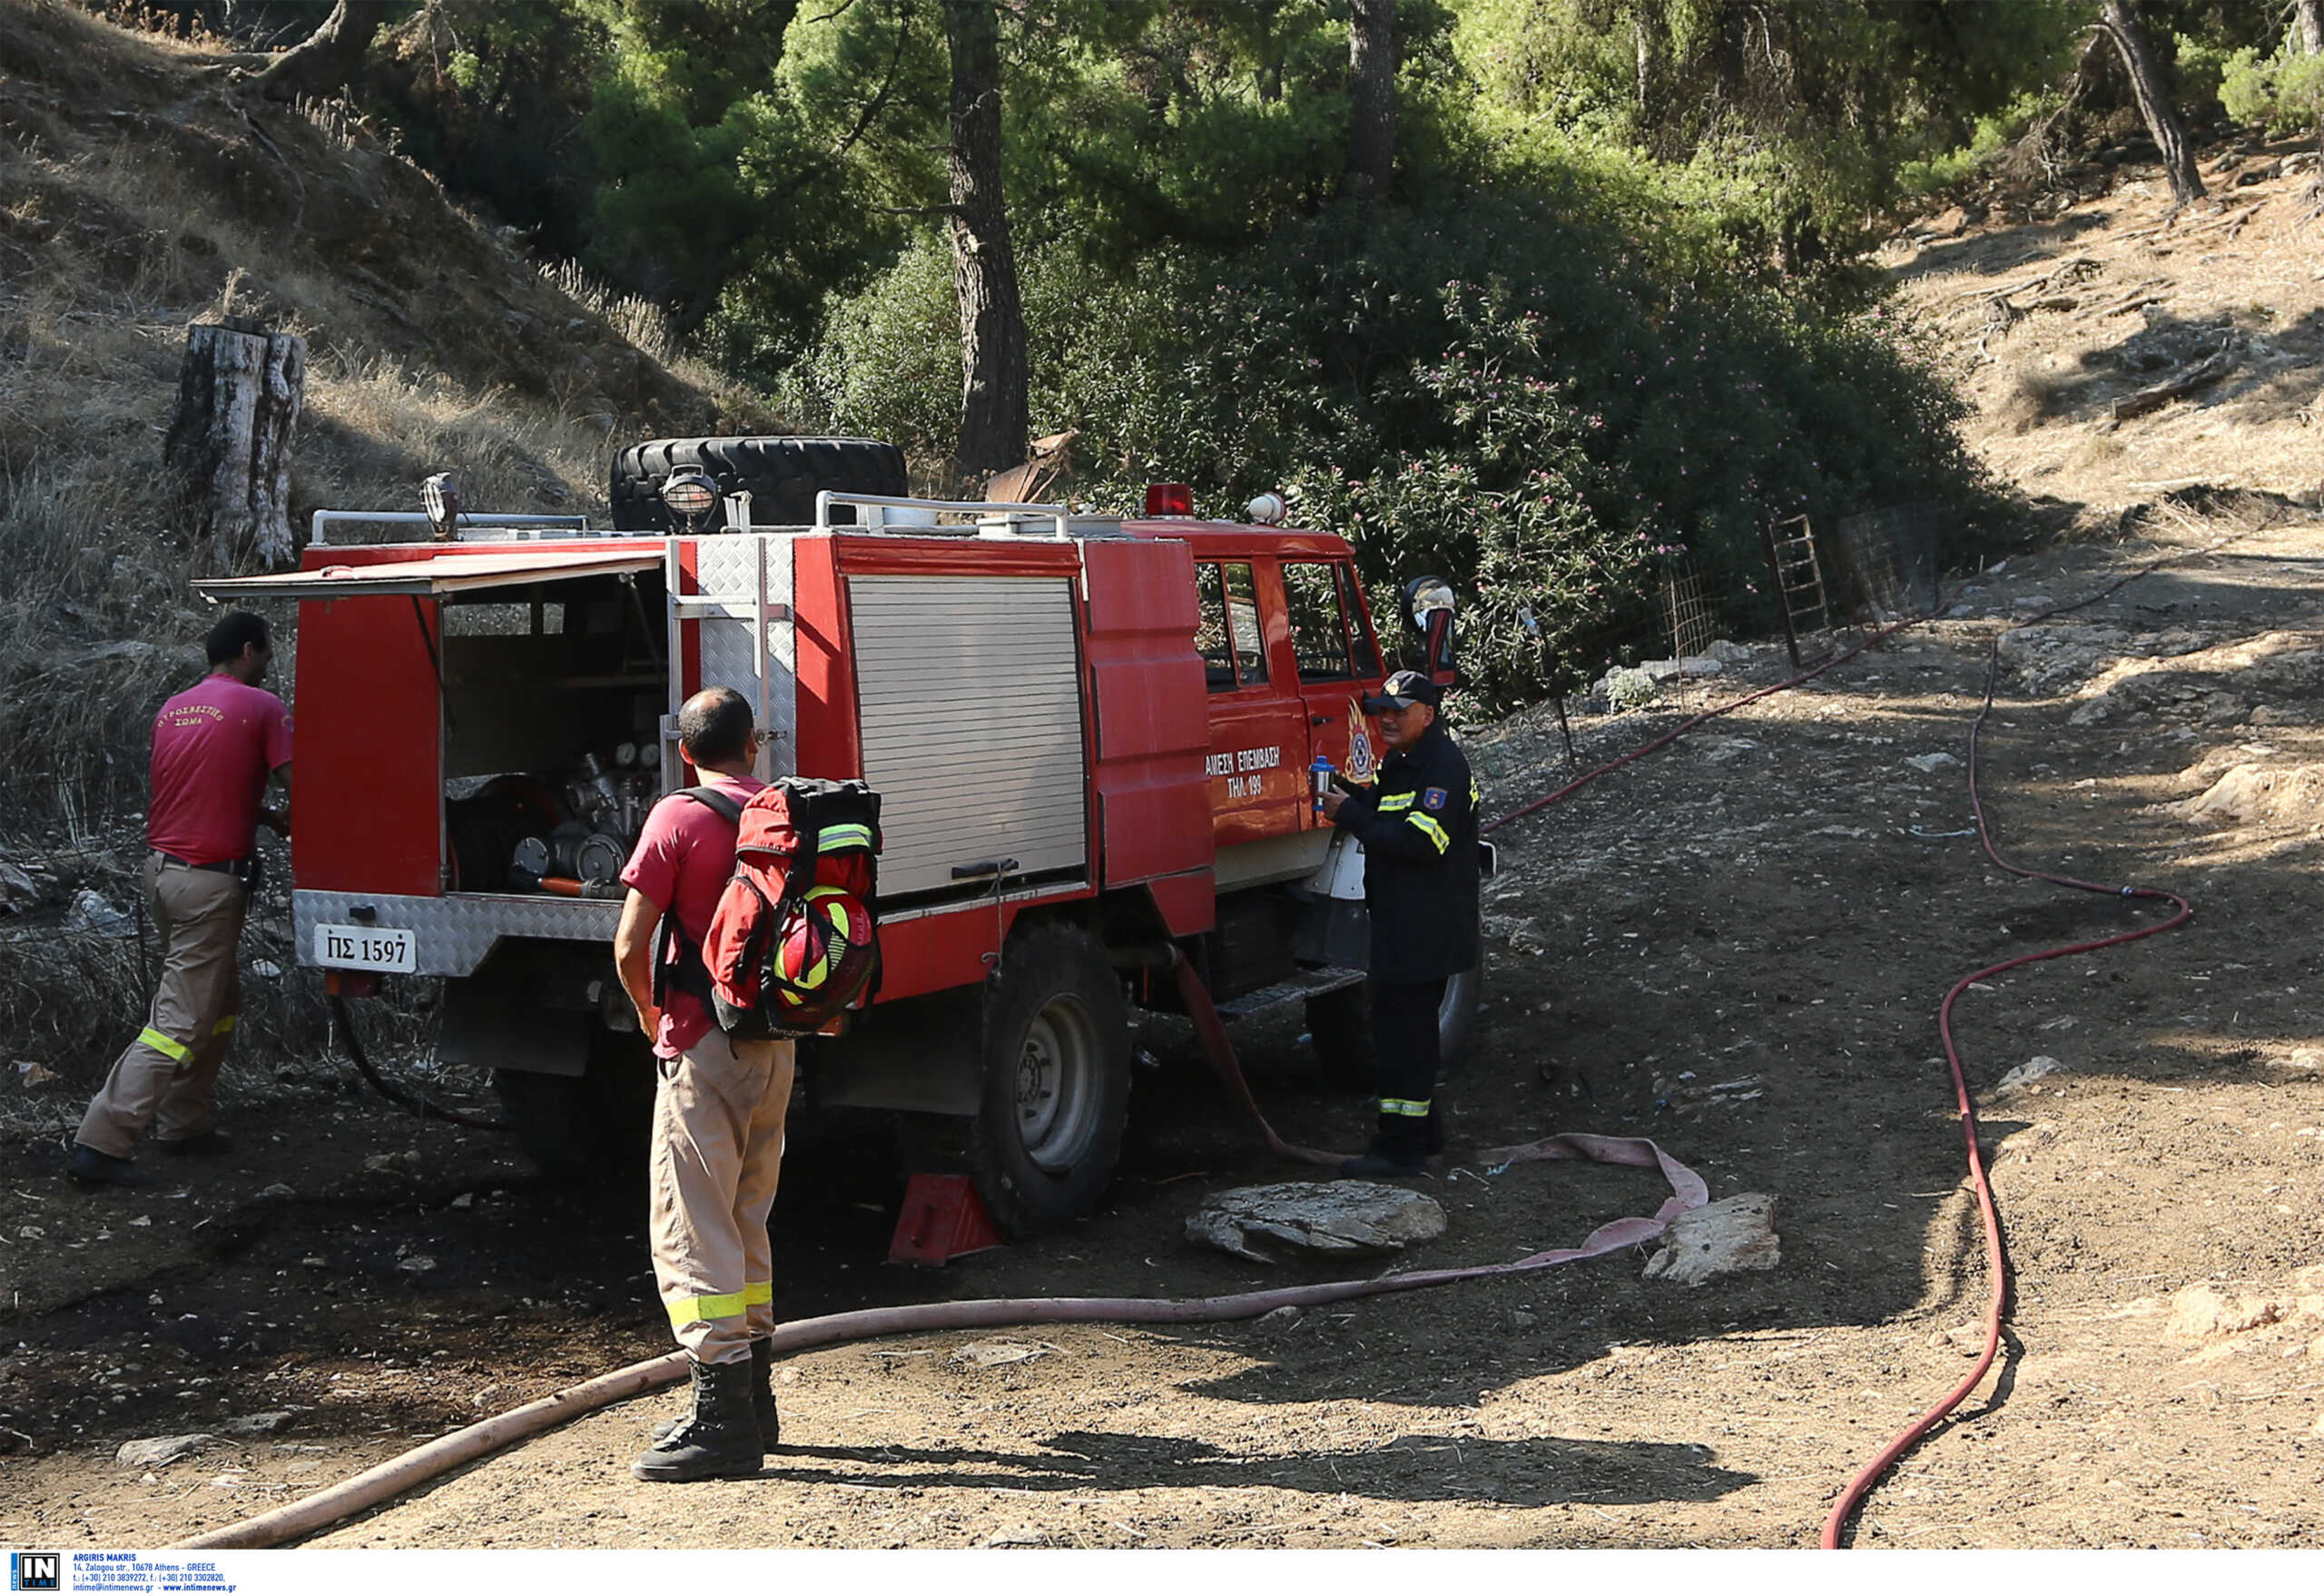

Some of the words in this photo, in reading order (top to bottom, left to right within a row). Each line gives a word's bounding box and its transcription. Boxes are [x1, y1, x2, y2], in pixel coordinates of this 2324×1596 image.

[174, 716, 203, 726] ΣΩΜΑ
[1206, 752, 1235, 776] ΑΜΕΣΗ
[1237, 745, 1280, 773] ΕΠΕΜΒΑΣΗ
[1227, 776, 1247, 799] ΤΗΛ.
[1248, 773, 1262, 795] 199
[328, 936, 355, 960] ΠΣ
[361, 940, 406, 964] 1597
